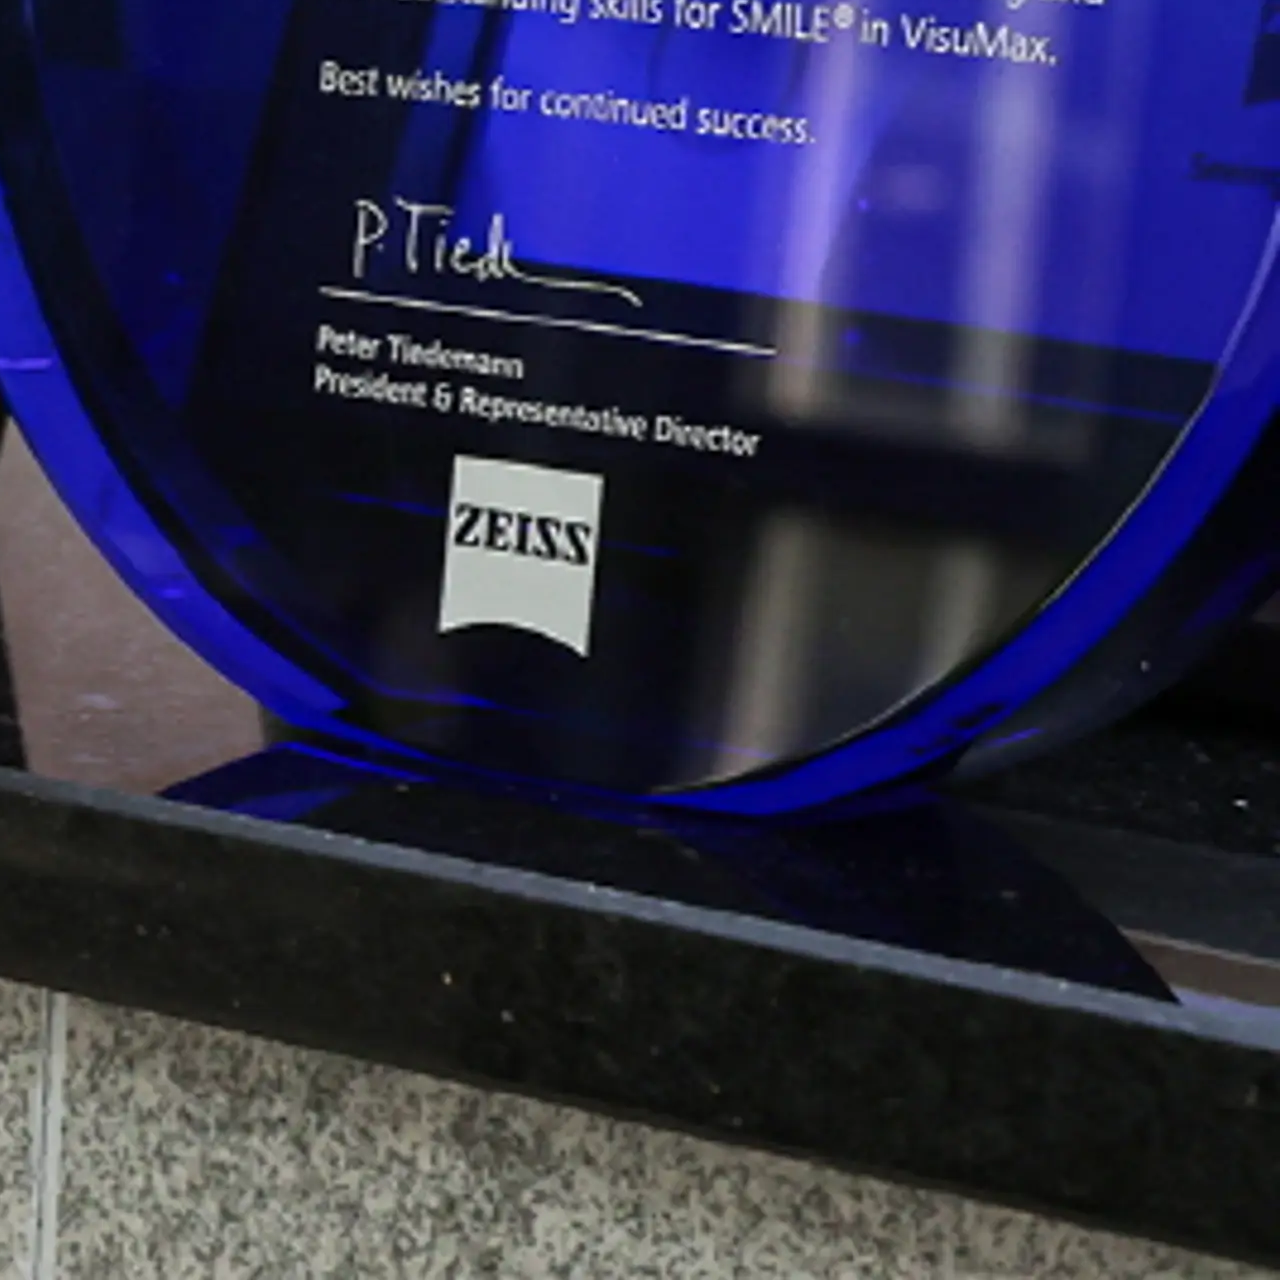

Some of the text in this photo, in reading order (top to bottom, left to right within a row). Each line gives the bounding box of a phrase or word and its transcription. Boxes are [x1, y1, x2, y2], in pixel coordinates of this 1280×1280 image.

[859, 8, 890, 48] in
[900, 13, 1058, 66] VisuMax.
[318, 60, 817, 145] Best wishes for continued success.
[316, 324, 525, 380] Peter Tiedemann
[313, 365, 763, 457] President & Representative Director
[452, 501, 592, 567] ZEISS
